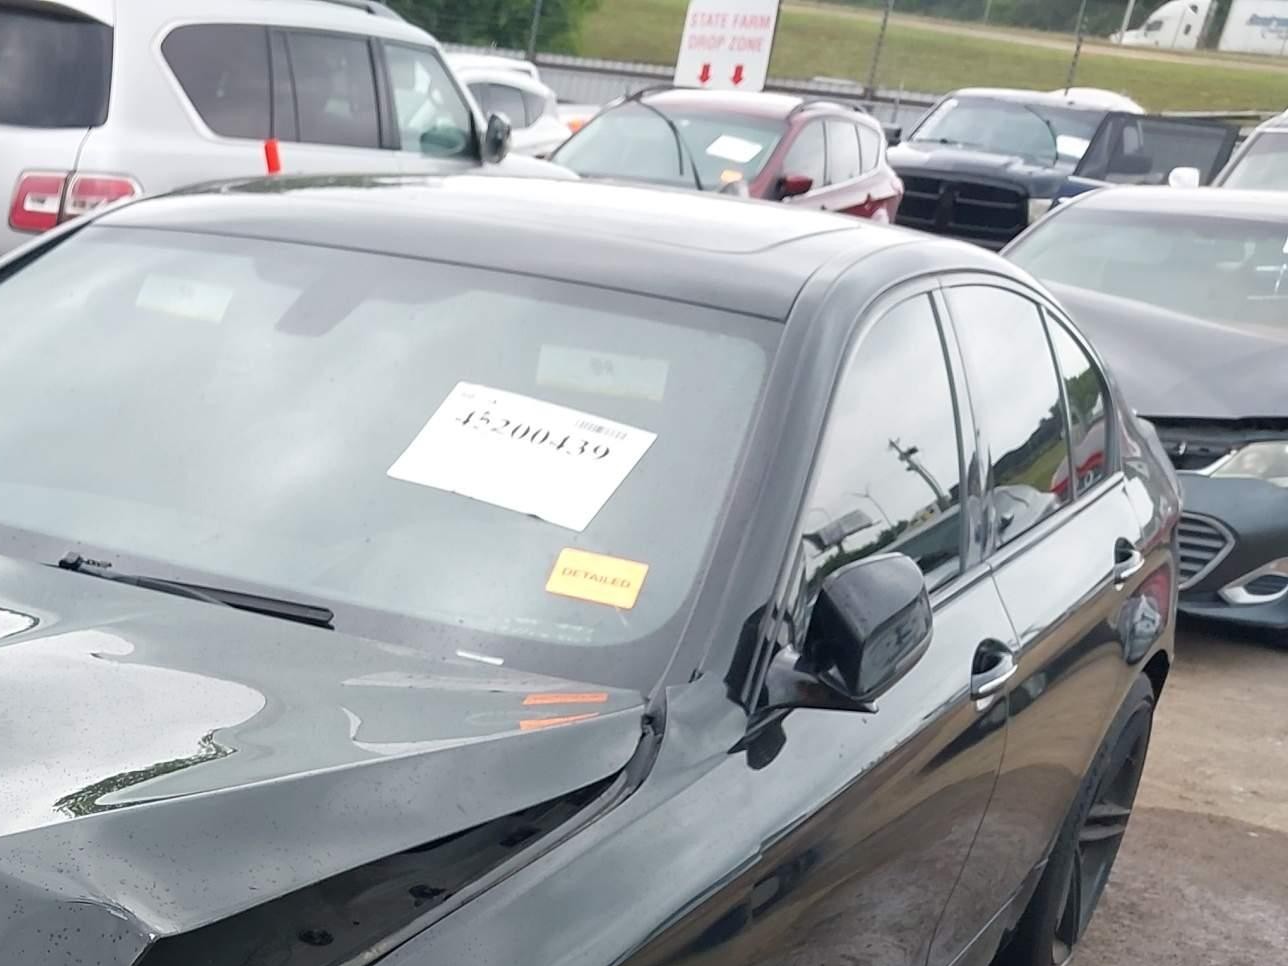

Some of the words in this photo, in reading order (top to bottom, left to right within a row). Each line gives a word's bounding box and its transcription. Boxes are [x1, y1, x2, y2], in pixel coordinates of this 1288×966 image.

[690, 12, 729, 28] STATE
[732, 13, 771, 29] FARM
[687, 33, 726, 50] DROP
[728, 35, 763, 52] ZONE
[455, 410, 611, 460] 45200439
[561, 567, 632, 588] DETAILED
